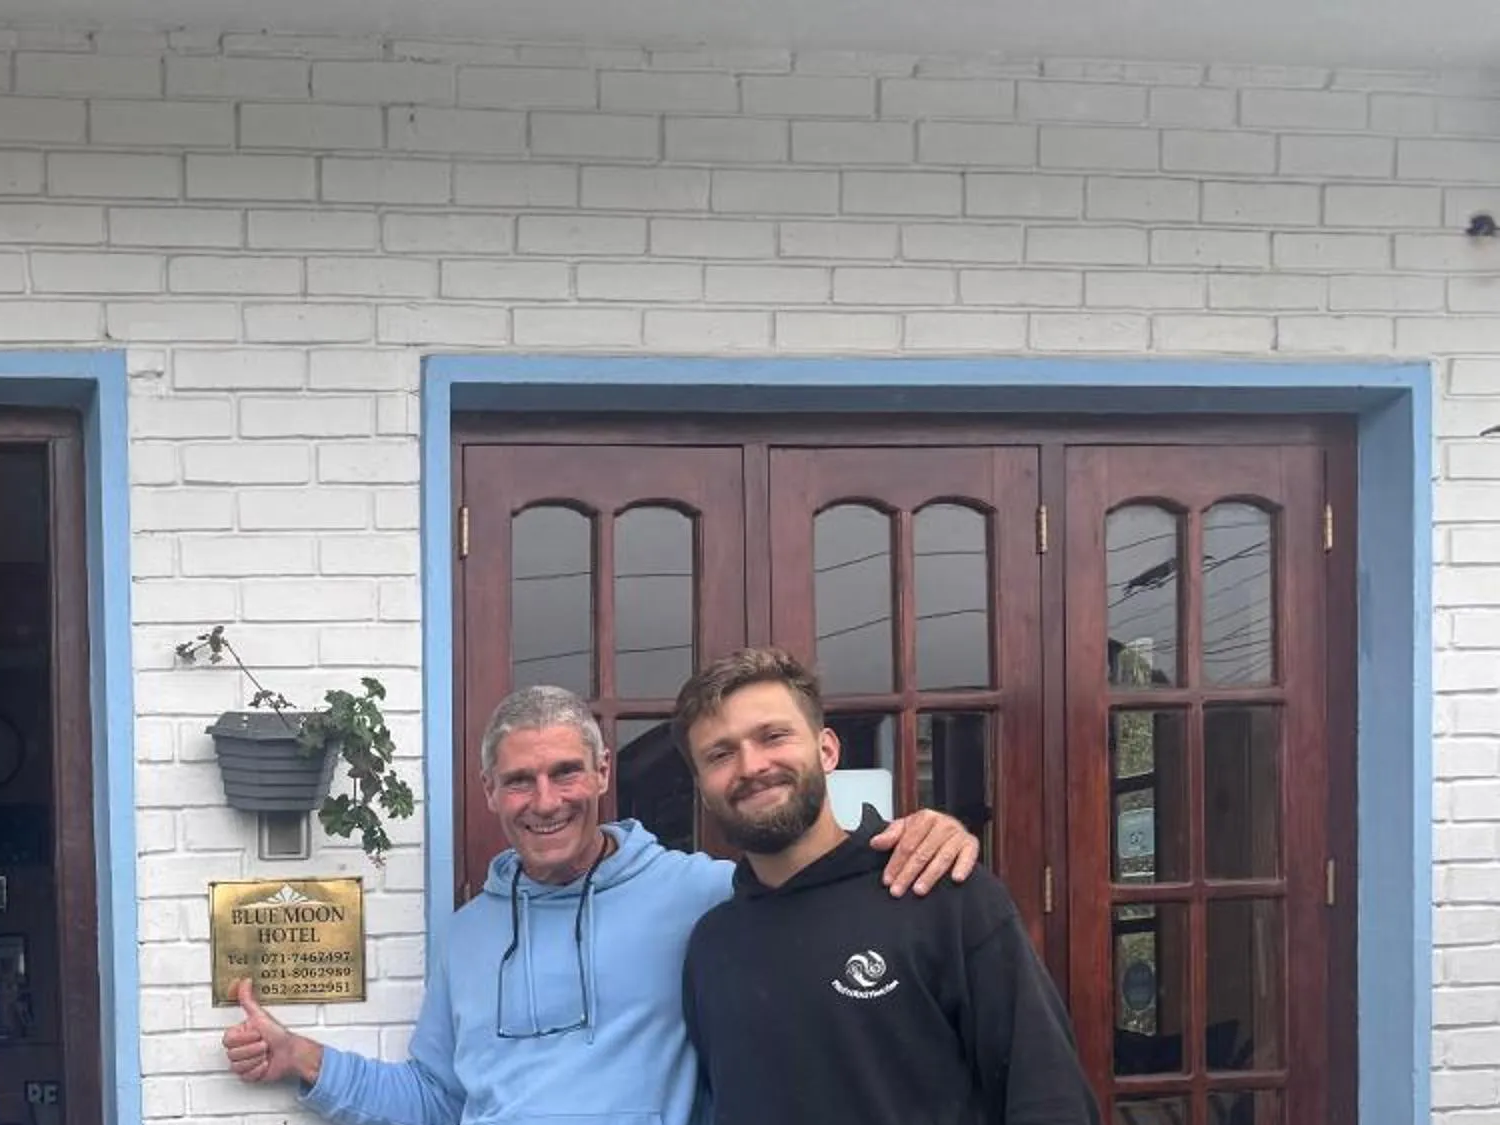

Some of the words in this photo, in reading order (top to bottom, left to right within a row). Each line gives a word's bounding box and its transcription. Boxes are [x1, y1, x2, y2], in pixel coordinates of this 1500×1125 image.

[231, 907, 279, 925] BLUE
[284, 906, 345, 923] MOON
[259, 927, 321, 943] HOTEL
